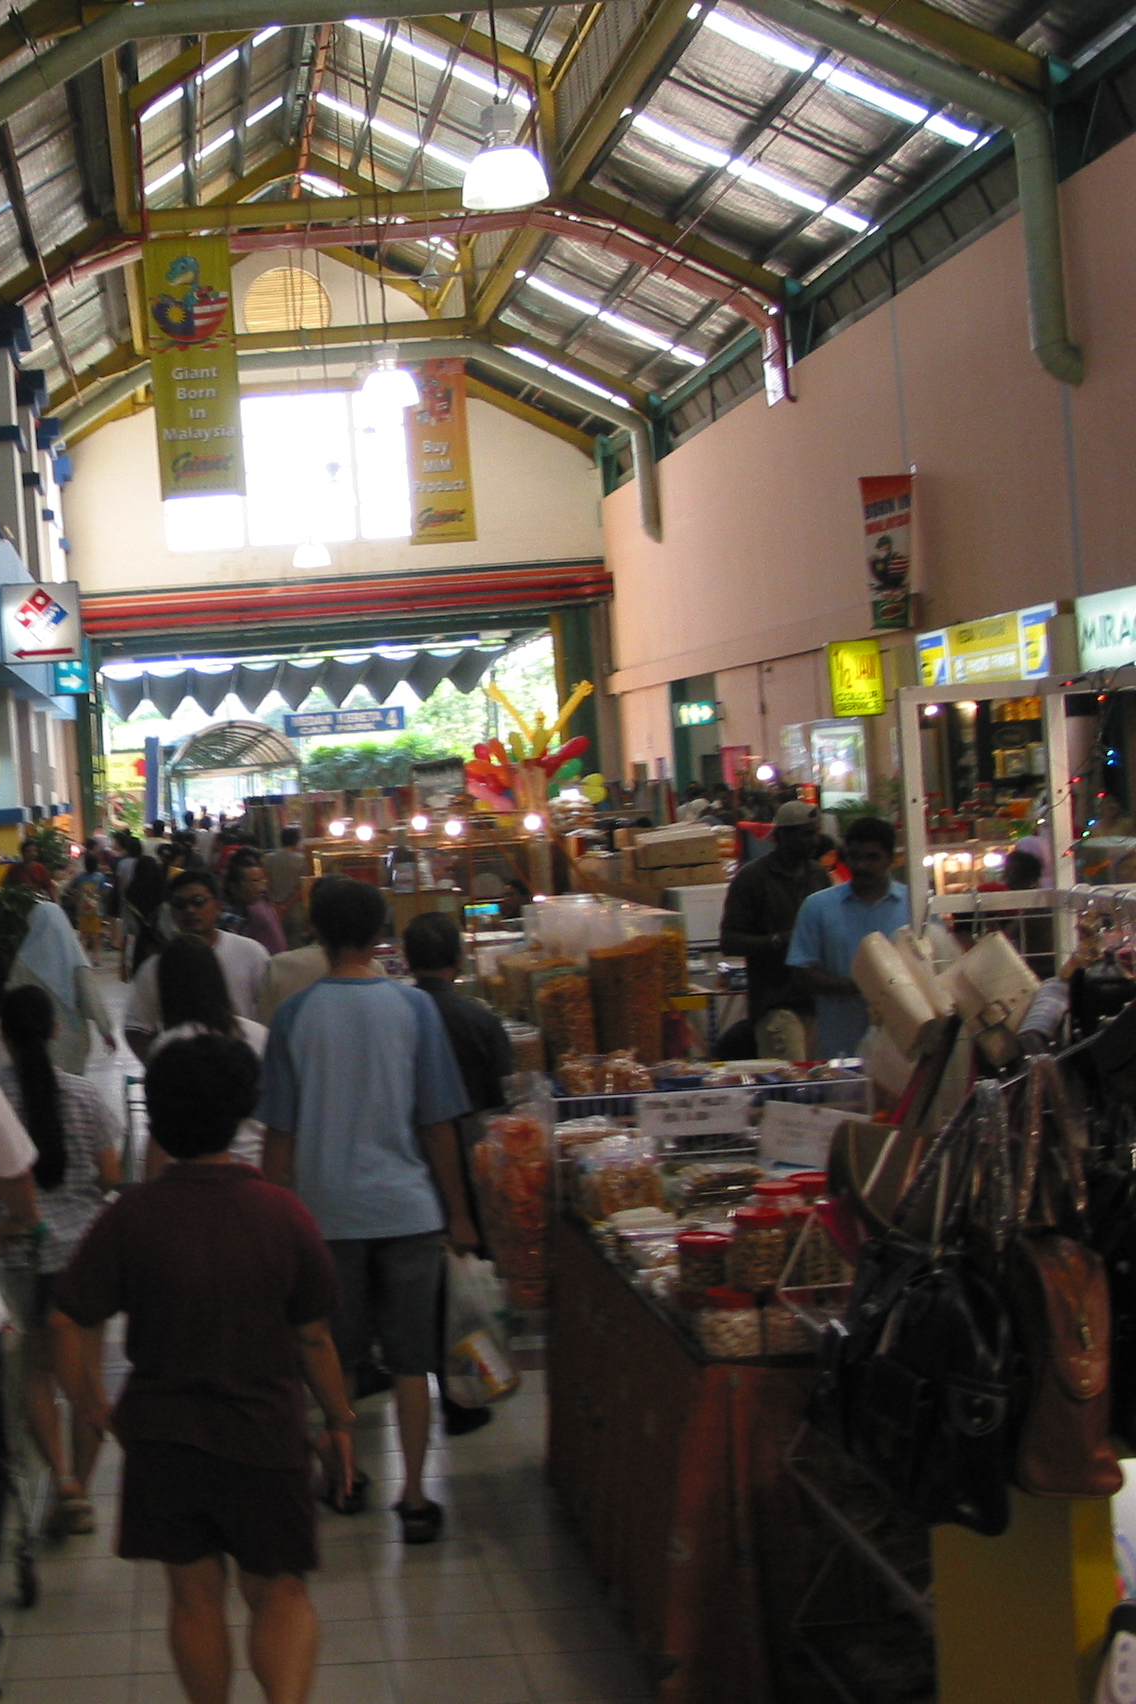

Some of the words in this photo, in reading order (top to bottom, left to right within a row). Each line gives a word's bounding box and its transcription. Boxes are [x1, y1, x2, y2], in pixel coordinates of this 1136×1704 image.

[172, 367, 219, 380] Giant
[176, 387, 217, 400] Born
[190, 407, 207, 419] In
[164, 424, 240, 441] Malaysia
[422, 440, 450, 456] Buy
[414, 479, 467, 493] Product
